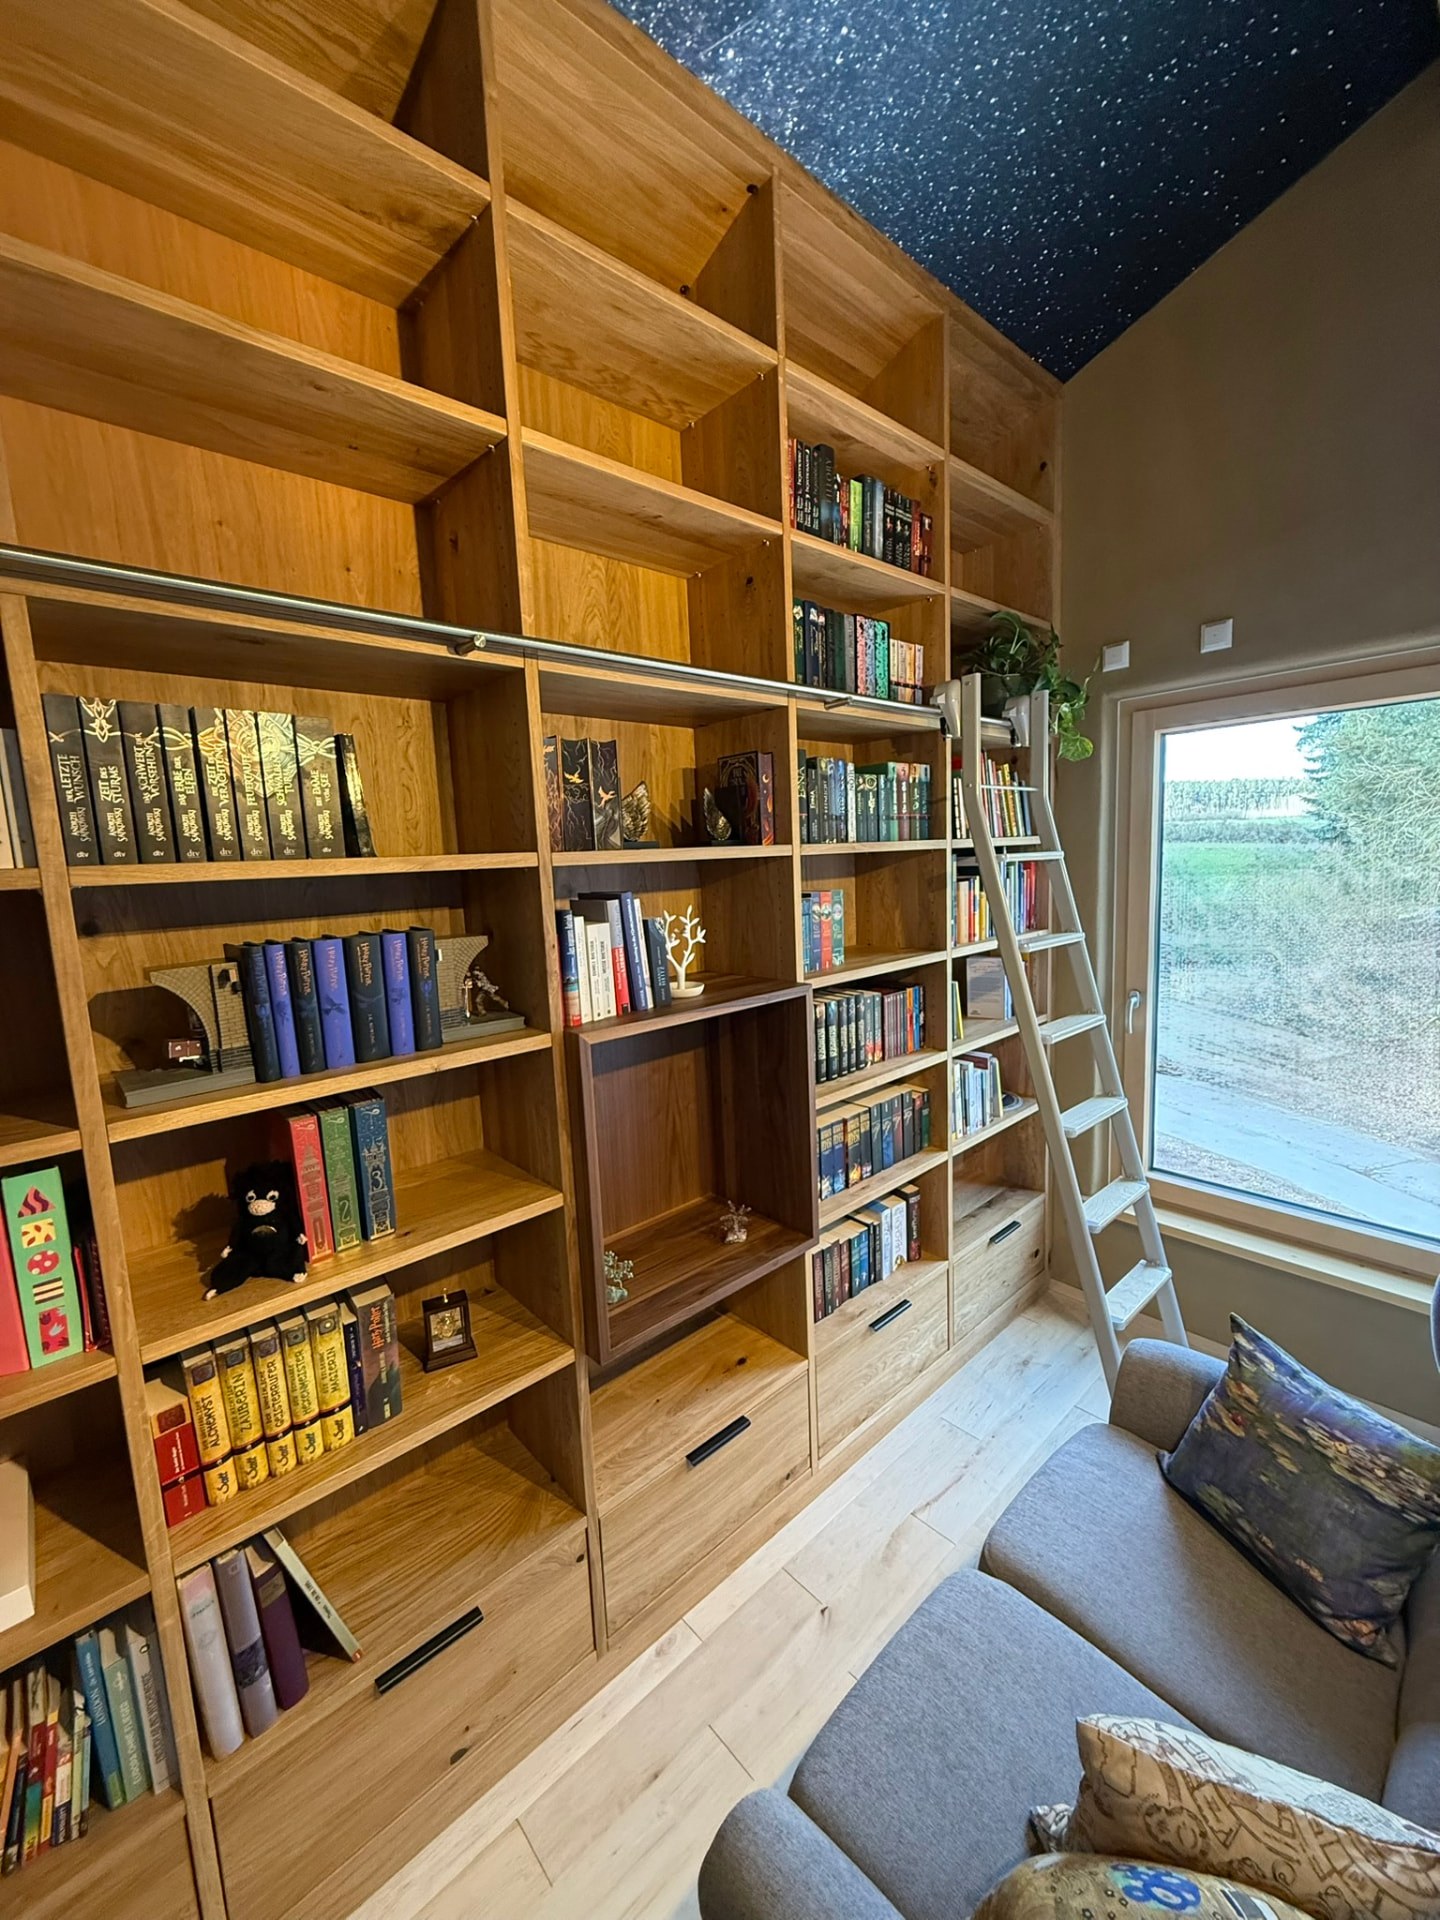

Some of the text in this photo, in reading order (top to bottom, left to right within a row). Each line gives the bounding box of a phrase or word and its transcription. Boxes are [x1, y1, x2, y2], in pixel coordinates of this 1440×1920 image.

[57, 754, 71, 789] LETZTE
[70, 756, 86, 803] WUNSCH
[108, 766, 125, 804] STURMS
[134, 745, 150, 791] SCHWERT
[144, 741, 160, 801] VORSEHUNG
[172, 770, 186, 794] ERBE
[183, 768, 196, 795] ELFEN
[205, 763, 219, 785] ZEIT
[214, 745, 230, 808] VERACHTUNG
[310, 769, 322, 795] DAME
[320, 773, 331, 788] SEE
[98, 779, 113, 802] ZEIT
[371, 1170, 383, 1192] 3
[368, 1306, 385, 1350] Harry Potter
[294, 1349, 312, 1415] HEXENMEISTER
[326, 1346, 340, 1394] MAGIERIN
[233, 1372, 253, 1433] ZAUBERIN
[267, 1359, 285, 1428] GEISTERRUFER
[201, 1394, 220, 1448] ALCHEMYST
